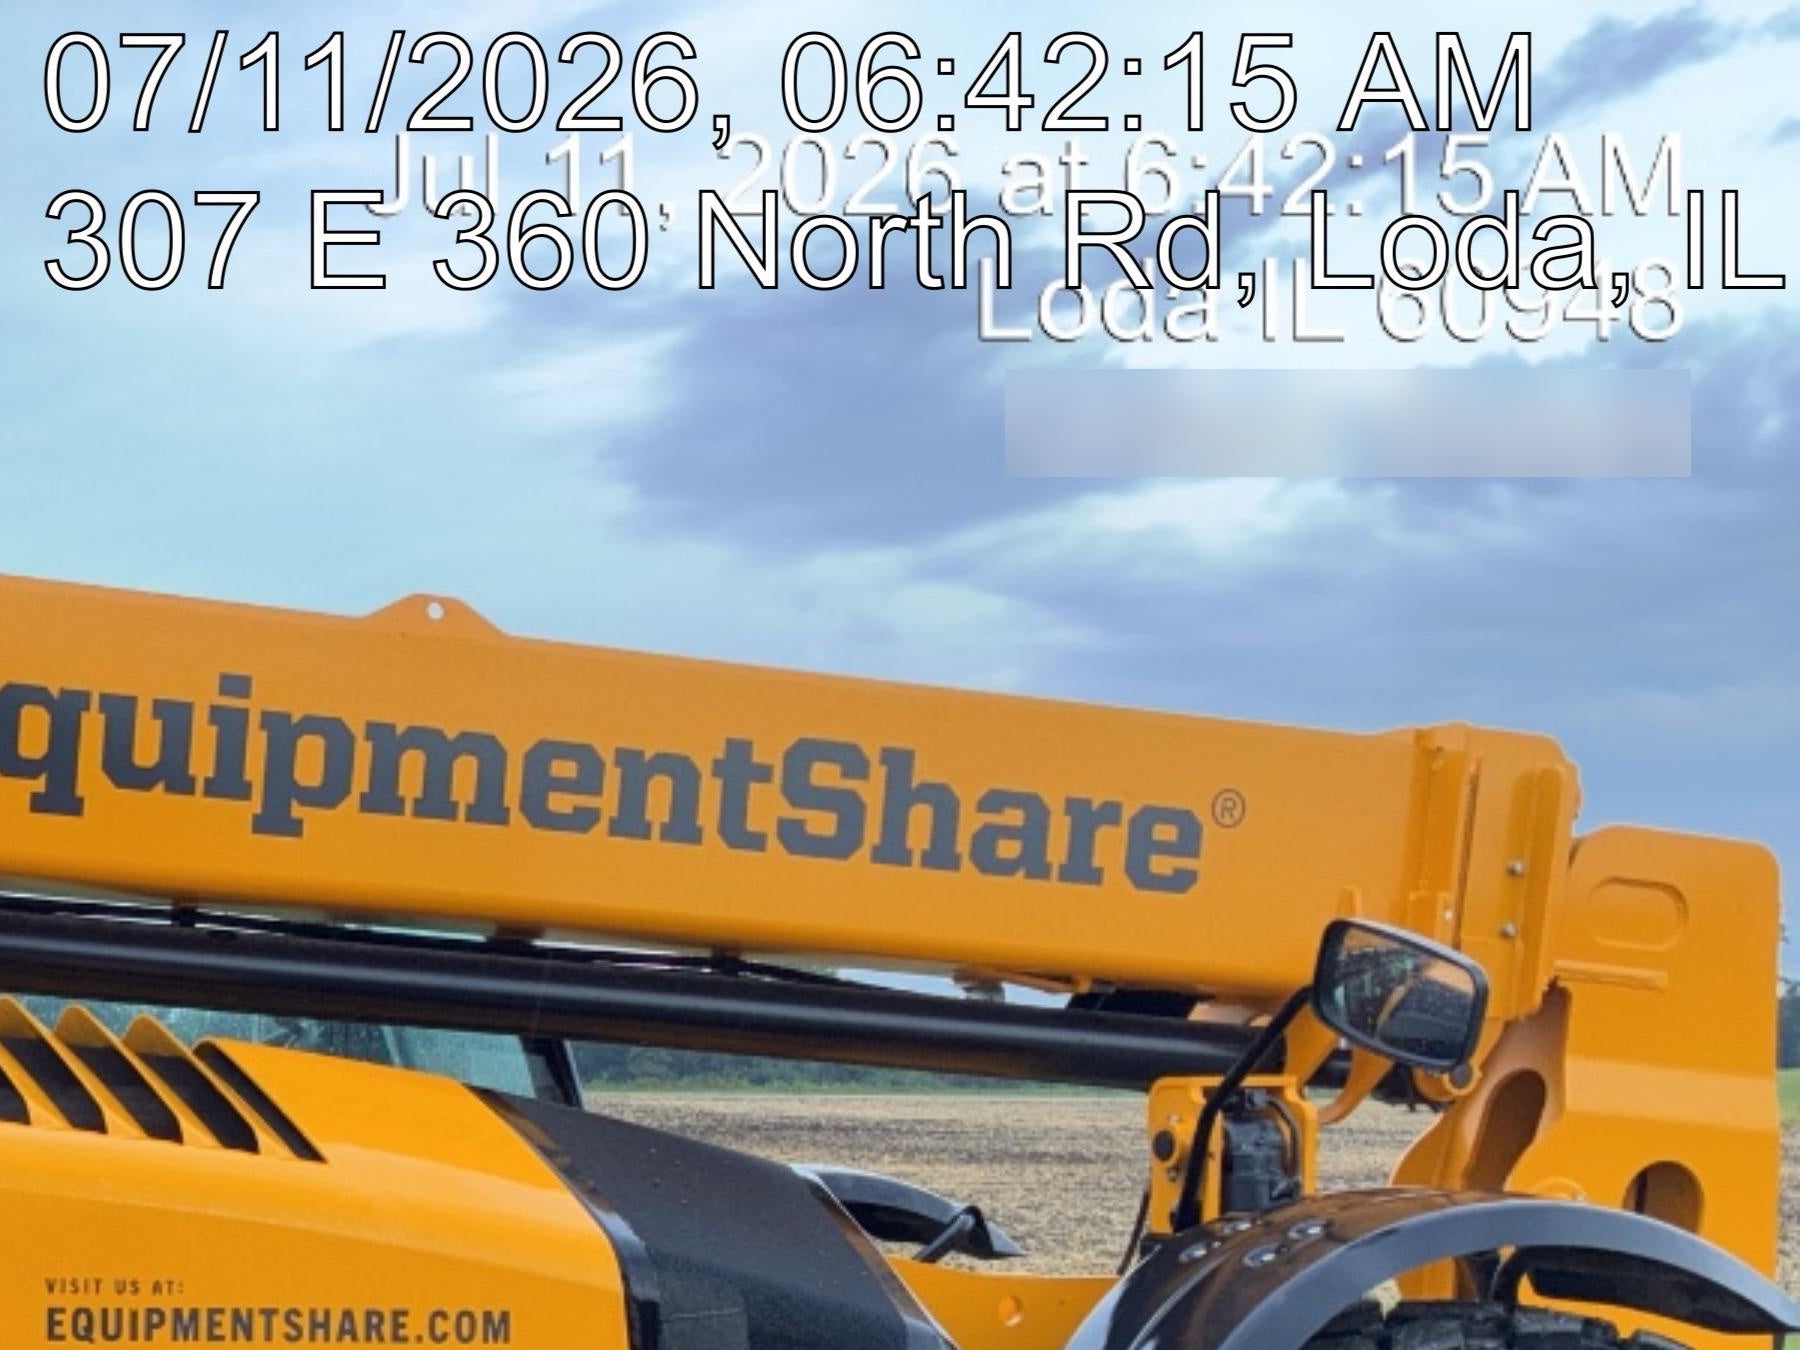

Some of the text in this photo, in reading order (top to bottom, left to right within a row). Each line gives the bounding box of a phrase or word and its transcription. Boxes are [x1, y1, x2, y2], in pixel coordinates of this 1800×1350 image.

[45, 1278, 185, 1296] VISIT US AT:
[46, 1306, 513, 1345] EQUIPMENTSHARE.COM
